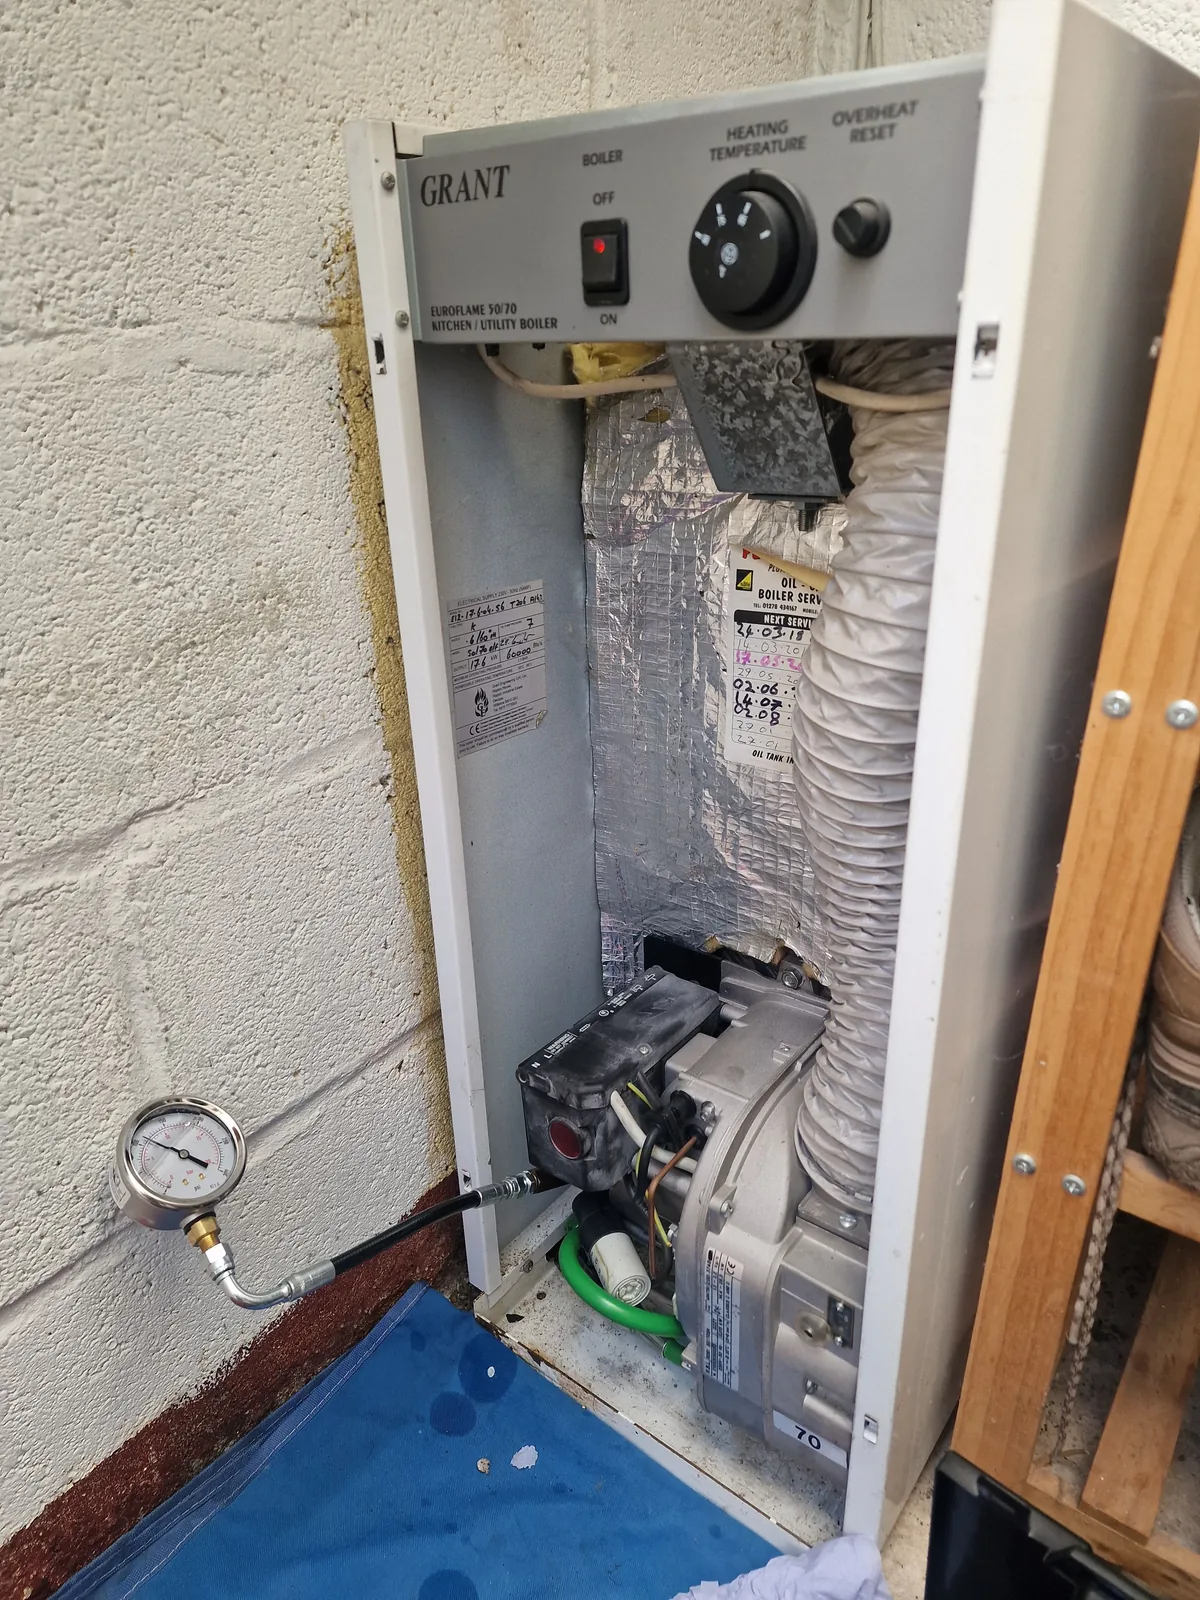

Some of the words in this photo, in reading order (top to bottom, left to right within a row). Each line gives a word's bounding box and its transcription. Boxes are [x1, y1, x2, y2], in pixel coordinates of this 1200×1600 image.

[832, 100, 918, 127] OVERHEAT
[727, 119, 788, 141] HEATING
[850, 123, 897, 143] RESET
[710, 135, 807, 162] TEMPERATURE
[582, 150, 623, 166] BOILER
[421, 165, 510, 207] GRANT
[593, 191, 615, 205] OFF
[431, 304, 485, 317] EUROFLAME
[489, 303, 517, 315] 50/70
[432, 319, 472, 331] KITCHEN
[481, 318, 516, 330] UTILITY
[520, 317, 558, 329] BOILER
[600, 314, 617, 325] ON
[782, 578, 797, 588] OIL
[482, 593, 498, 601] SUPPLY
[758, 589, 794, 602] BOILER
[798, 592, 822, 605] SERV
[764, 614, 785, 625] NEXT
[752, 750, 762, 758] OIL
[766, 752, 783, 762] TANK
[795, 1425, 821, 1450] 70
